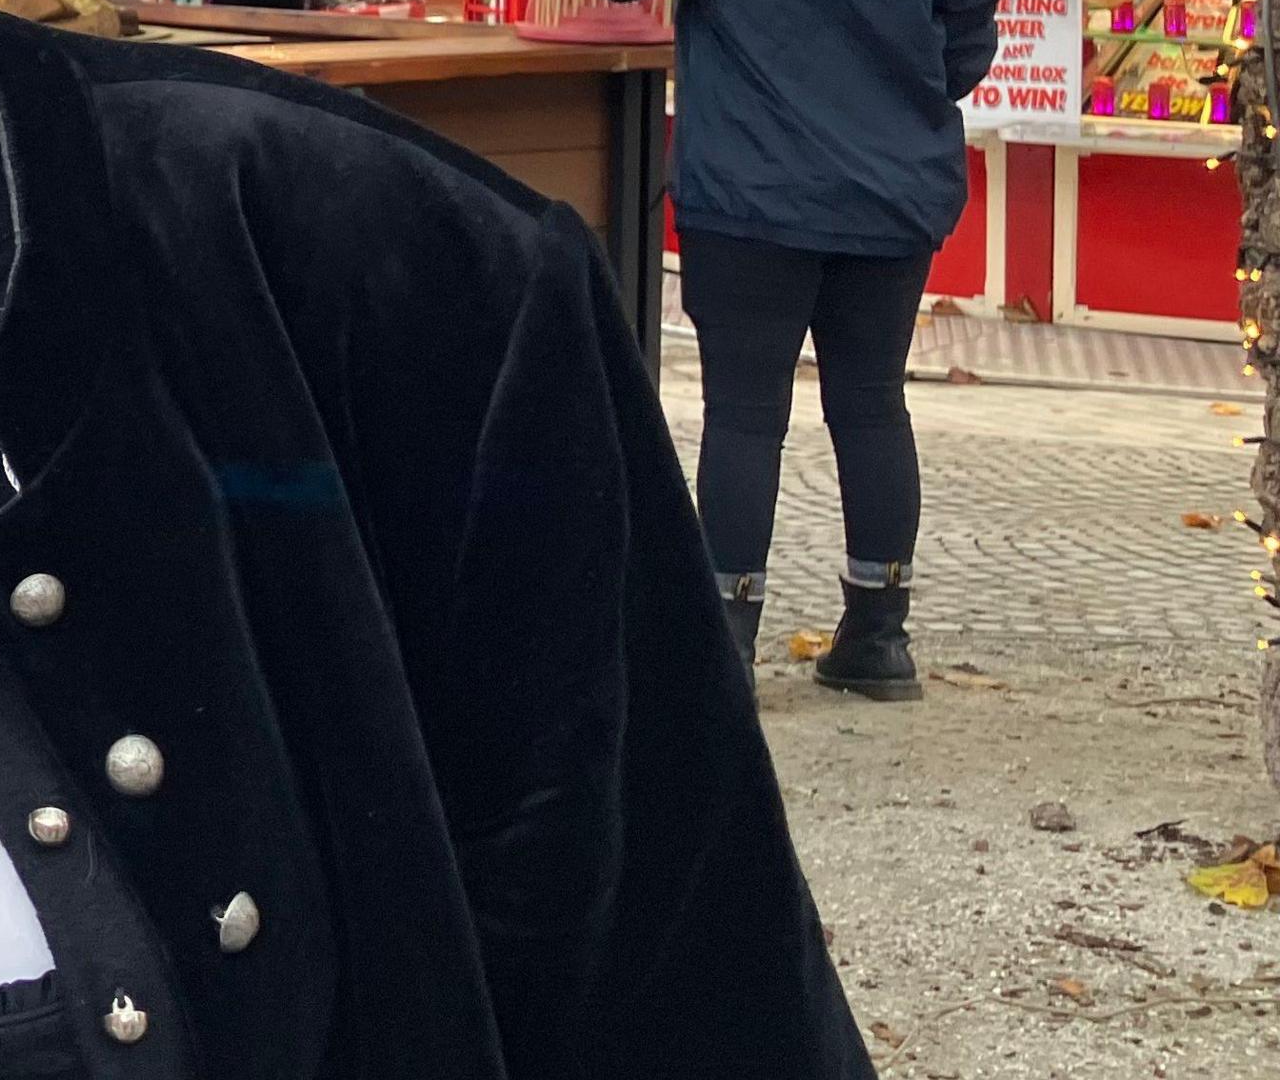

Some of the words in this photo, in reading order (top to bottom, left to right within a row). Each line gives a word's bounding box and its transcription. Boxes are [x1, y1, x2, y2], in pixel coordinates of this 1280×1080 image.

[1002, 42, 1034, 60] ANY
[988, 64, 1025, 82] ONE
[1030, 65, 1068, 84] BOX
[971, 83, 1002, 109] TO
[1007, 85, 1068, 113] WIN!
